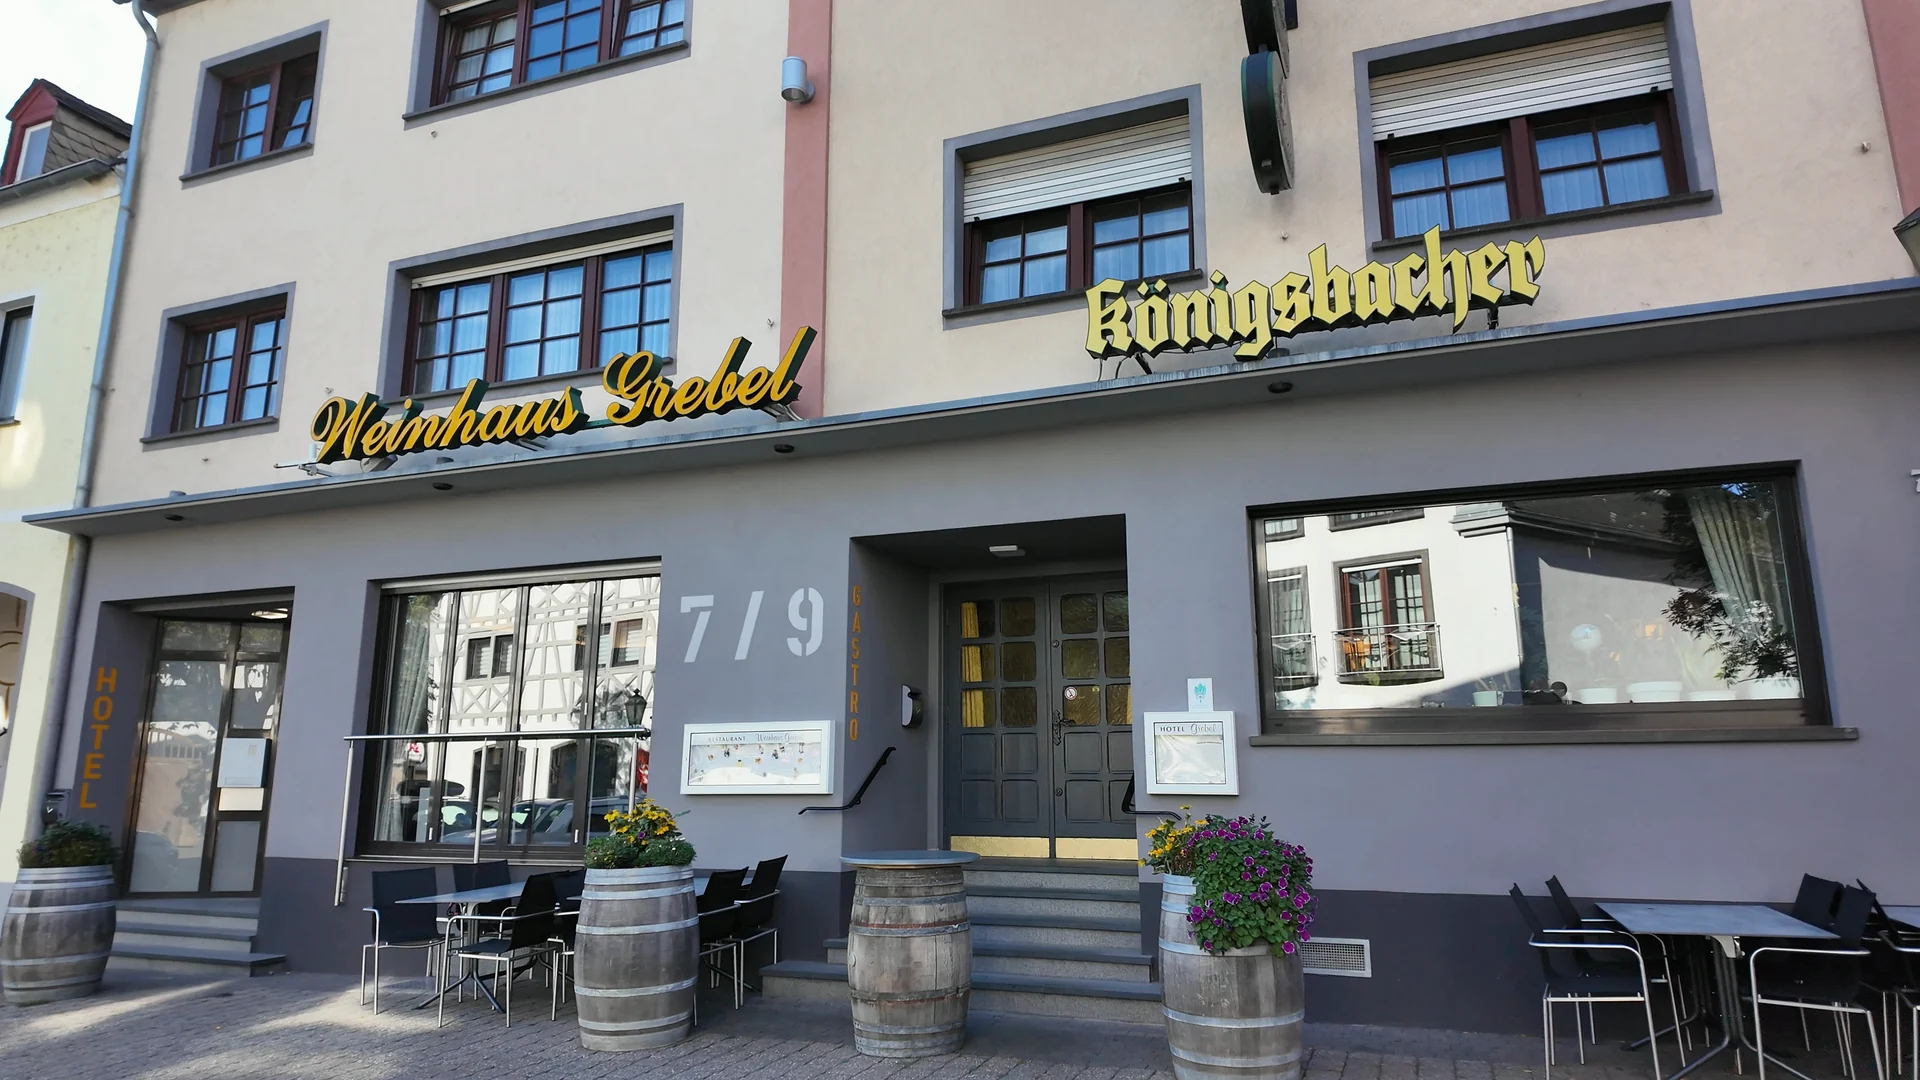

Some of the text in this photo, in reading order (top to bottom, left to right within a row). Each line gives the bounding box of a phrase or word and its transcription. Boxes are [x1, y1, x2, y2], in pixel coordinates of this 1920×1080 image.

[1085, 224, 1546, 360] Königsbacher
[310, 326, 817, 463] Weinhaus Grebel
[849, 585, 862, 741] GASTRO
[79, 667, 118, 809] HOTEL
